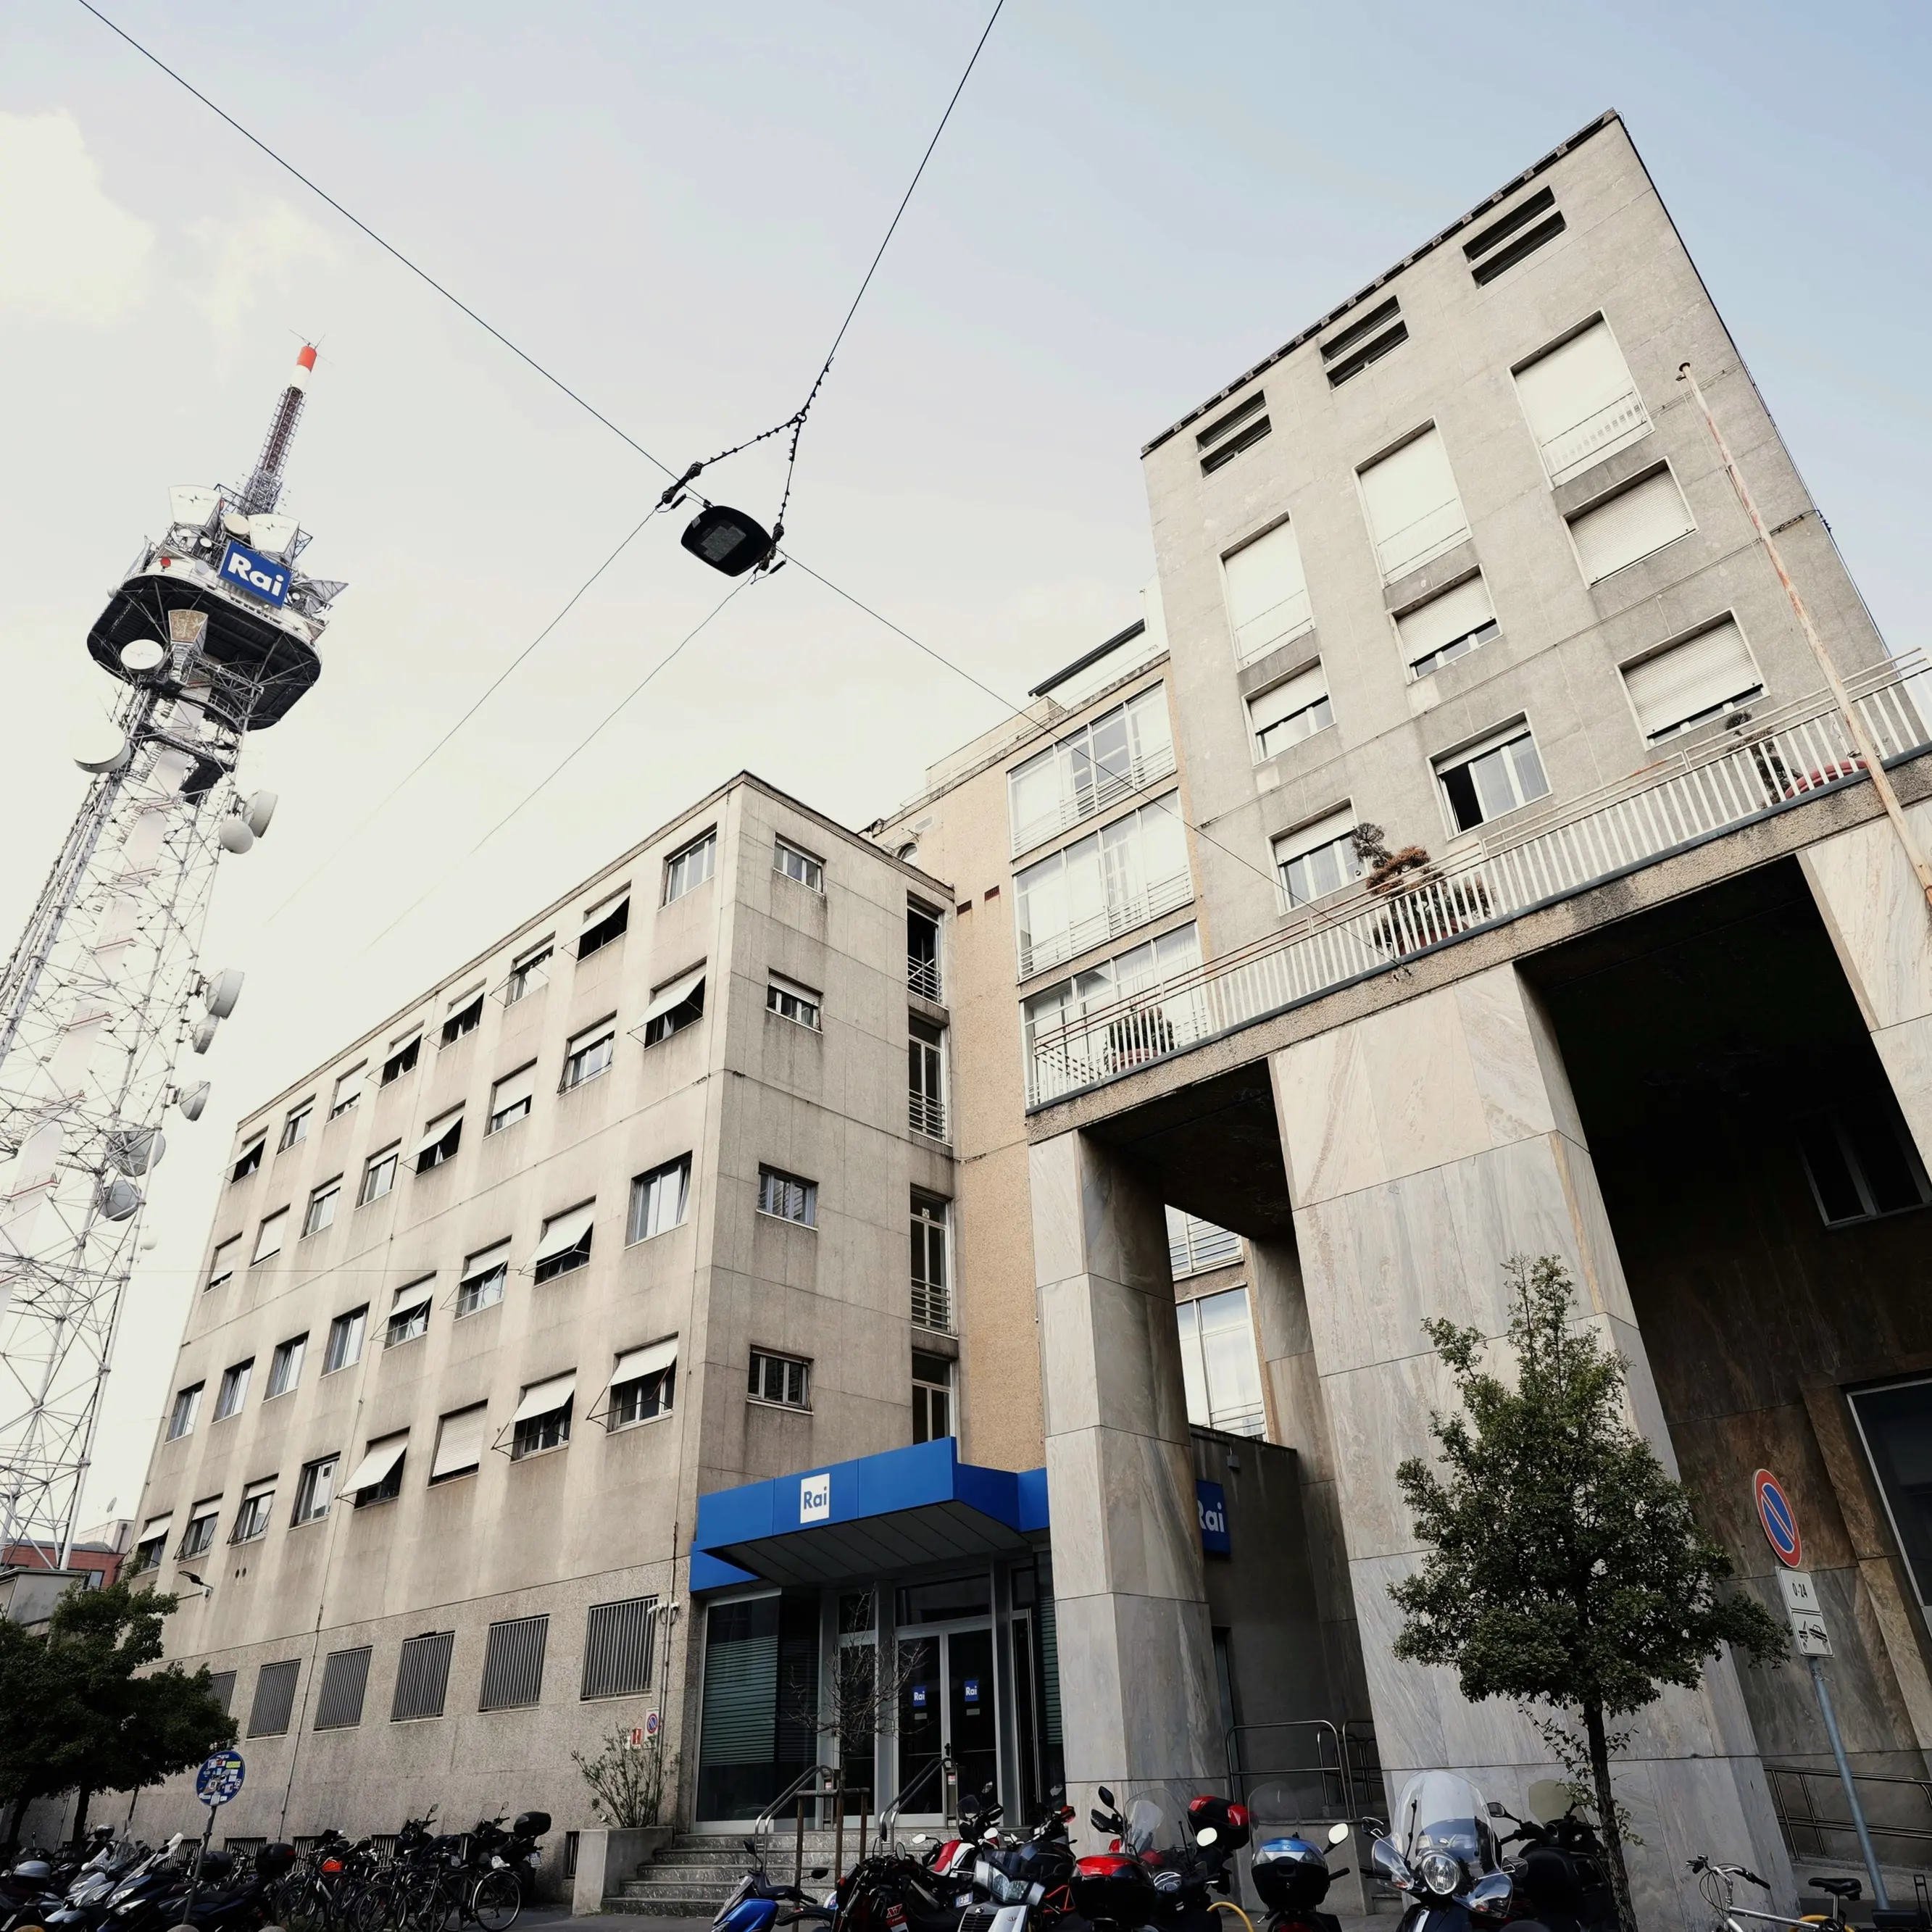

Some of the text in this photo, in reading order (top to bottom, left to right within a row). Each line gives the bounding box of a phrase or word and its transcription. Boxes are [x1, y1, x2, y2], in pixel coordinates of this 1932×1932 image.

[228, 552, 283, 596] Rai
[804, 1486, 827, 1510] Rai
[914, 1691, 925, 1701] Rai
[965, 1686, 977, 1696] Rai
